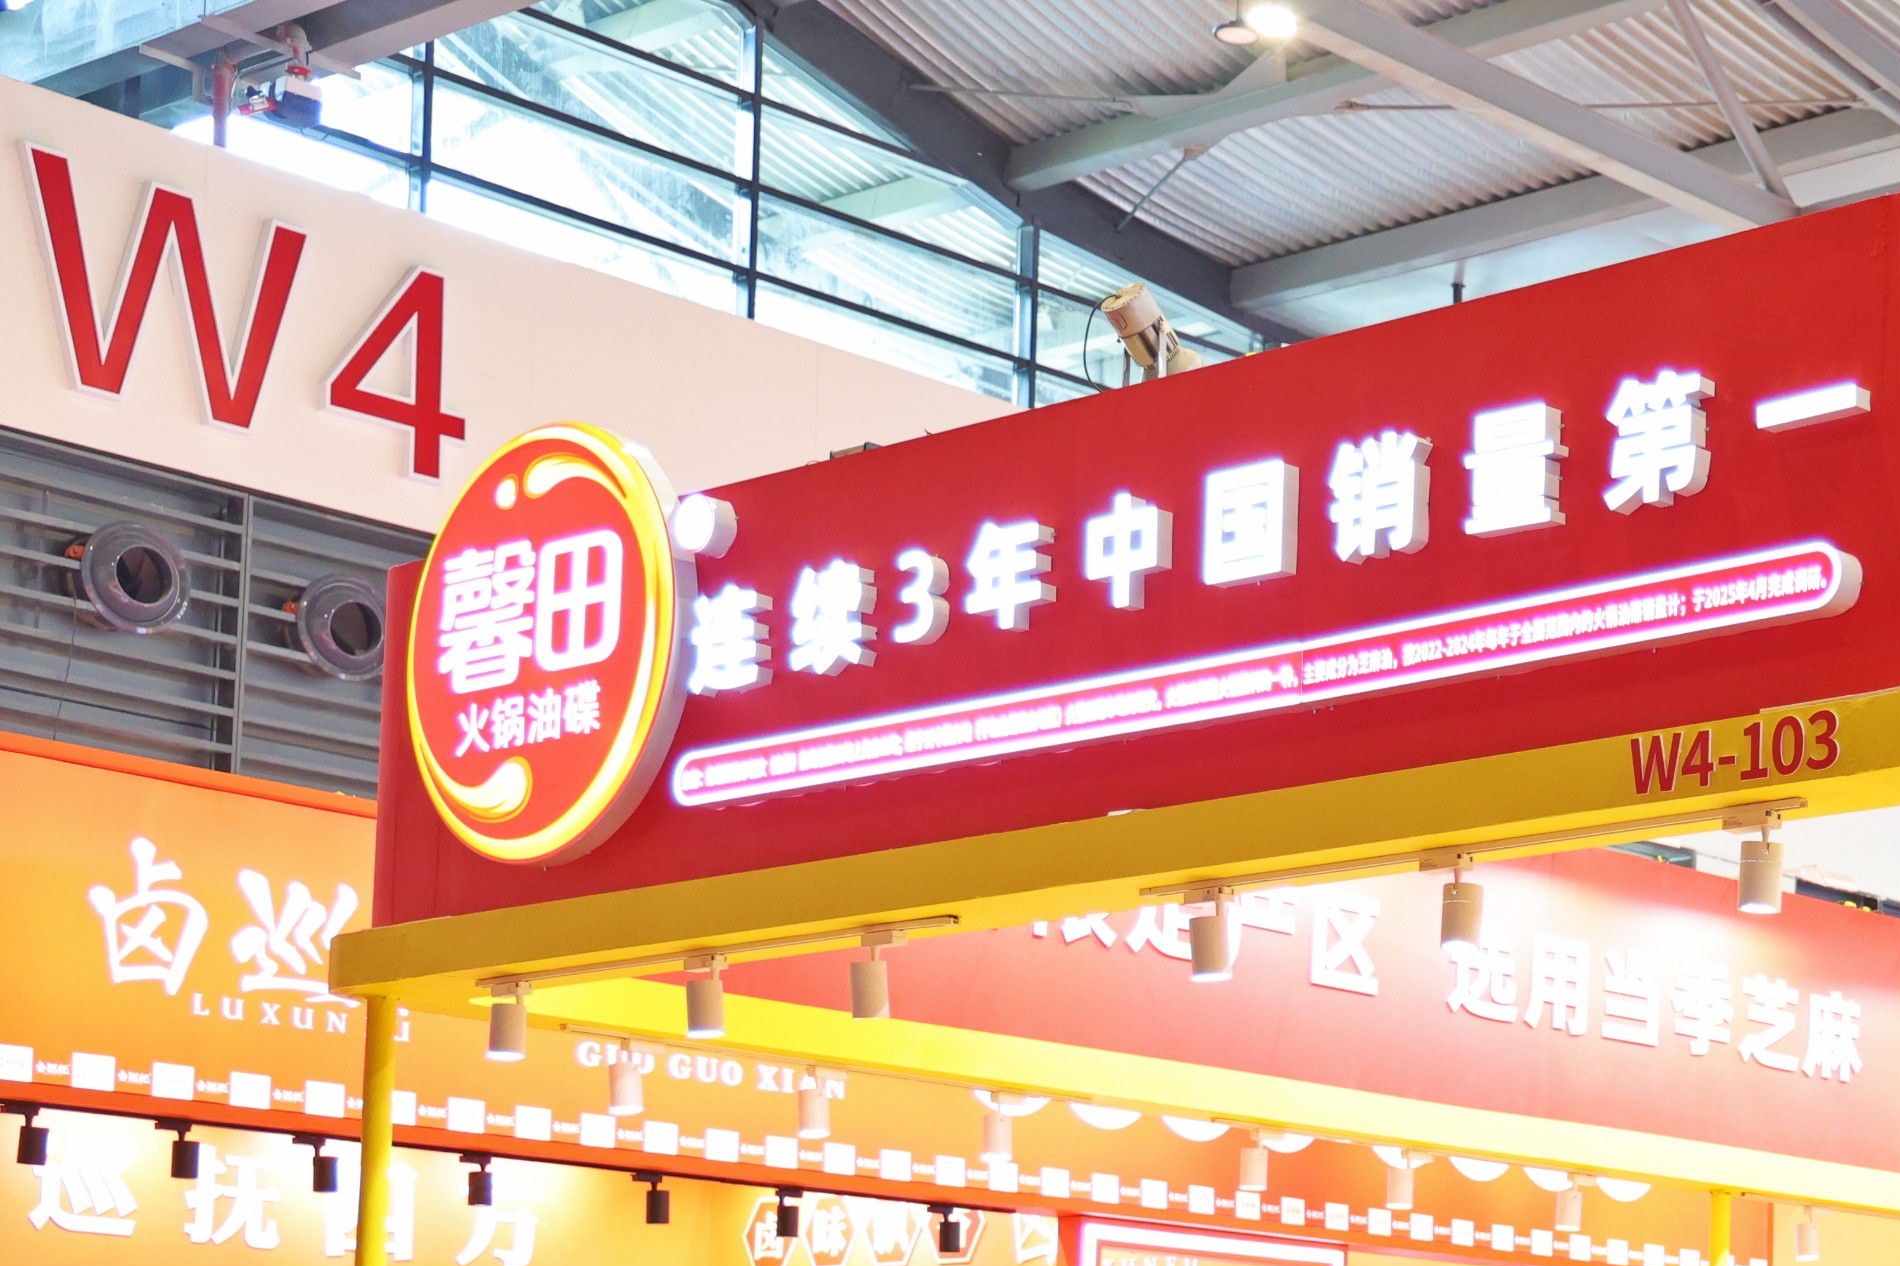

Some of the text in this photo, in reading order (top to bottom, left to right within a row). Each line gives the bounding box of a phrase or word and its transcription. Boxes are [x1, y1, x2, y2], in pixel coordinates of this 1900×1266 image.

[20, 140, 467, 484] W4
[689, 369, 1868, 697] 连续3年中国销量第一
[438, 530, 623, 694] 馨田
[453, 679, 602, 758] 火锅油碟
[1630, 709, 1840, 795] W4-103
[669, 1052, 743, 1086] GUO
